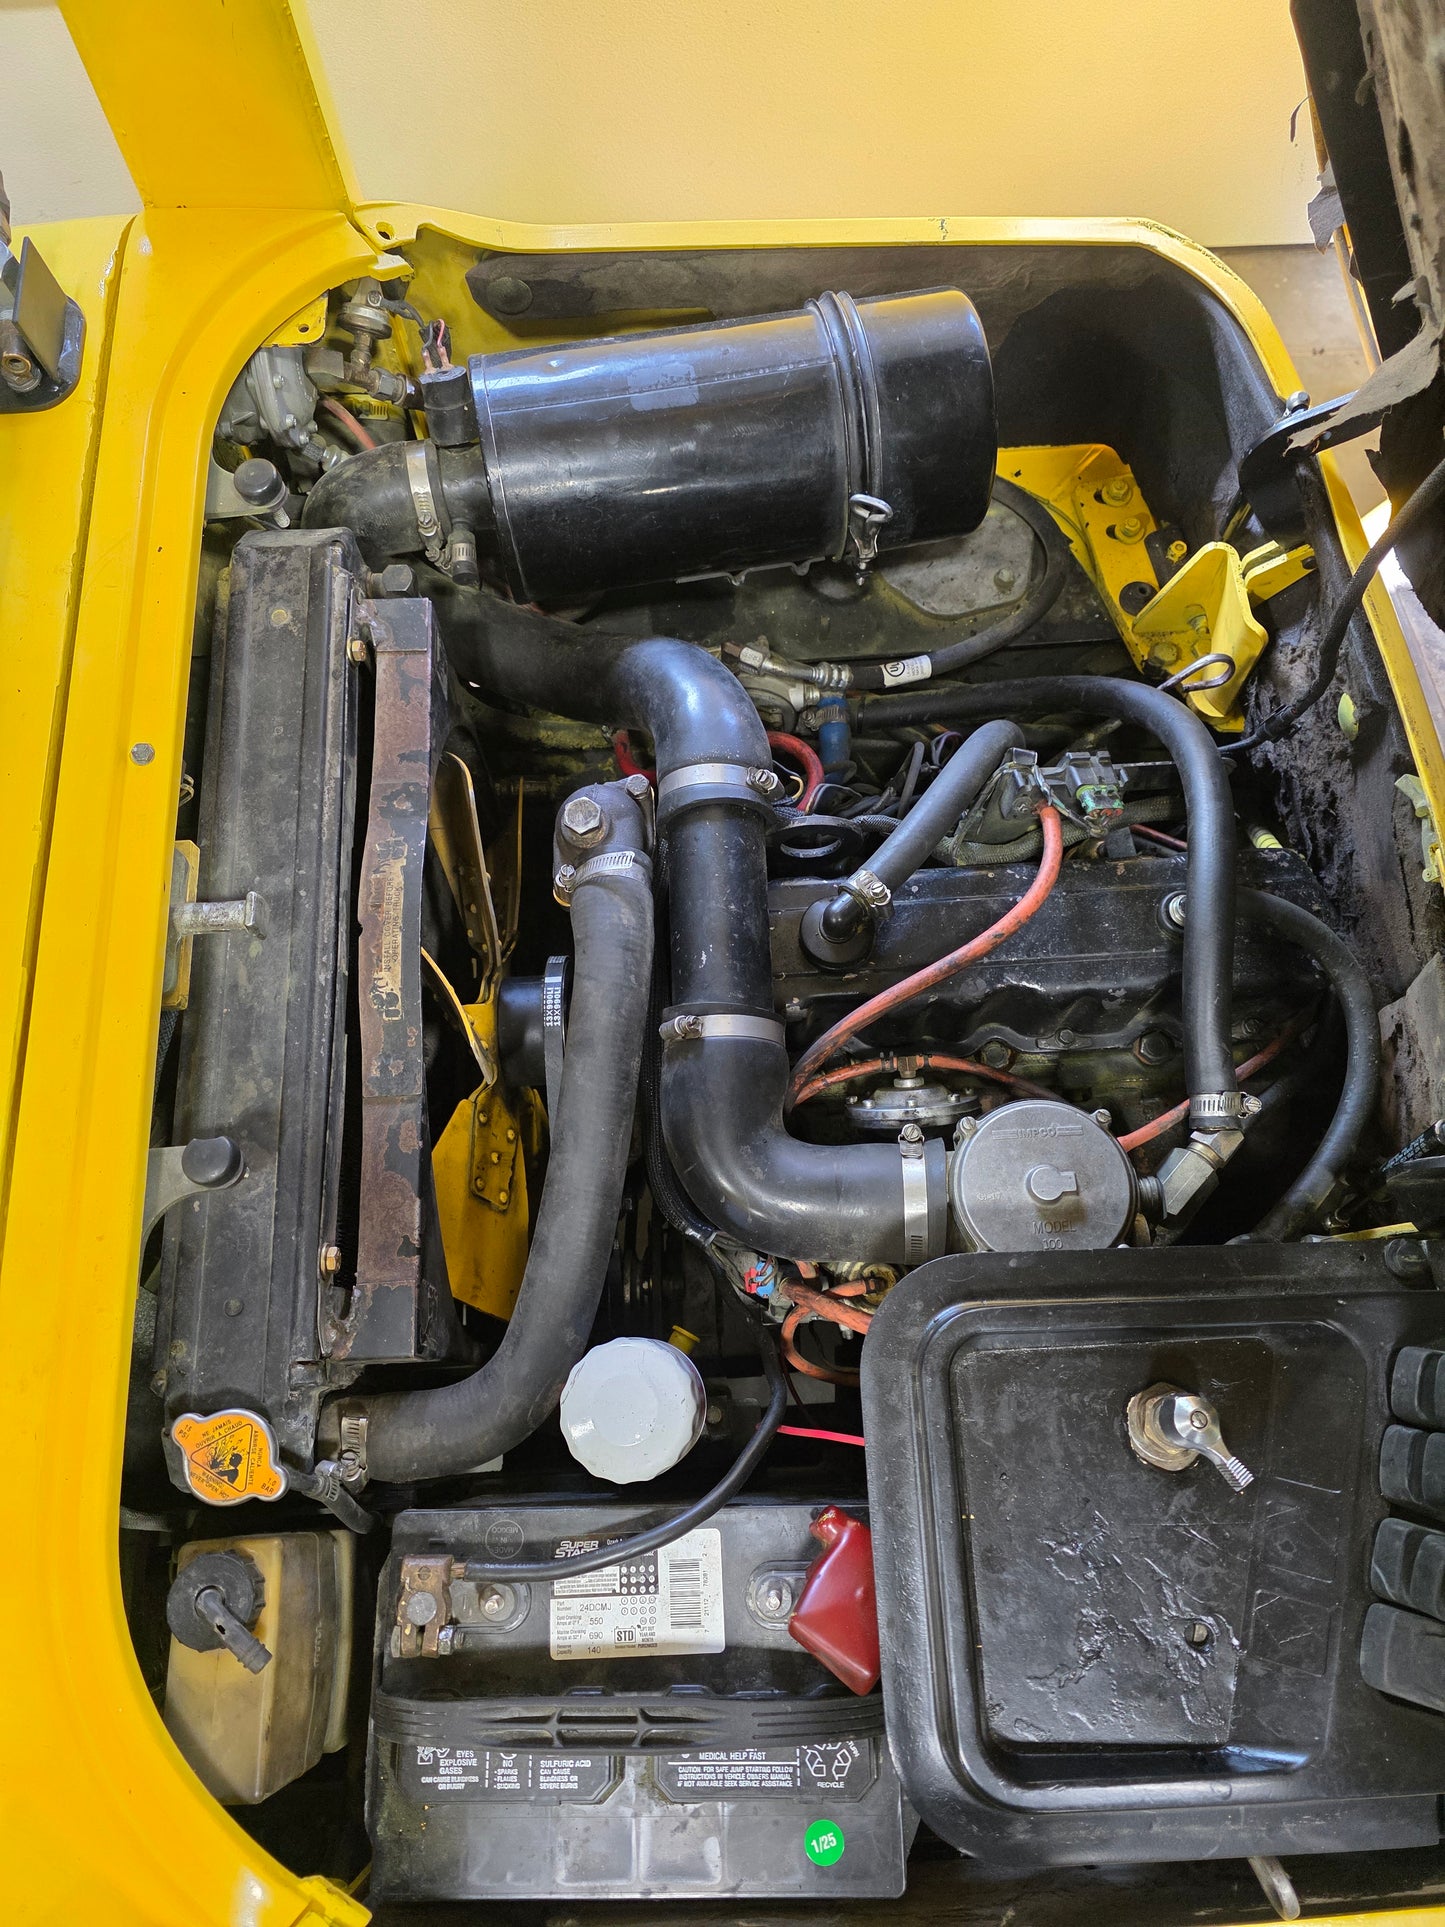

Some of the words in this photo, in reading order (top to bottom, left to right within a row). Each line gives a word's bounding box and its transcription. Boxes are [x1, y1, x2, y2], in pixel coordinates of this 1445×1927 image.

[385, 877, 394, 906] BEFORE
[393, 886, 401, 911] TRUCK
[384, 910, 392, 937] COVER
[392, 915, 400, 962] OPERATING
[1017, 1125, 1057, 1139] IMPCO
[1032, 1221, 1076, 1235] MODEL
[1042, 1239, 1064, 1250] 100
[212, 1419, 232, 1432] JAMAIS
[224, 1421, 243, 1434] CHAUD
[247, 1457, 256, 1486] CALIENTE
[267, 1477, 277, 1487] 1.0
[205, 1481, 219, 1493] OPEN
[220, 1490, 230, 1499] HOT
[260, 1483, 274, 1494] BAR
[560, 1540, 599, 1550] SUPER
[580, 1603, 612, 1611] 24DCMJ
[589, 1617, 604, 1626] 550
[589, 1631, 604, 1640] 690
[616, 1630, 634, 1642] STD
[587, 1646, 601, 1654] 140
[699, 1752, 728, 1760] MEDICAL
[730, 1752, 748, 1760] HELP
[749, 1752, 766, 1760] FAST
[439, 1767, 463, 1775] GASES
[811, 1833, 837, 1854] 1/25
